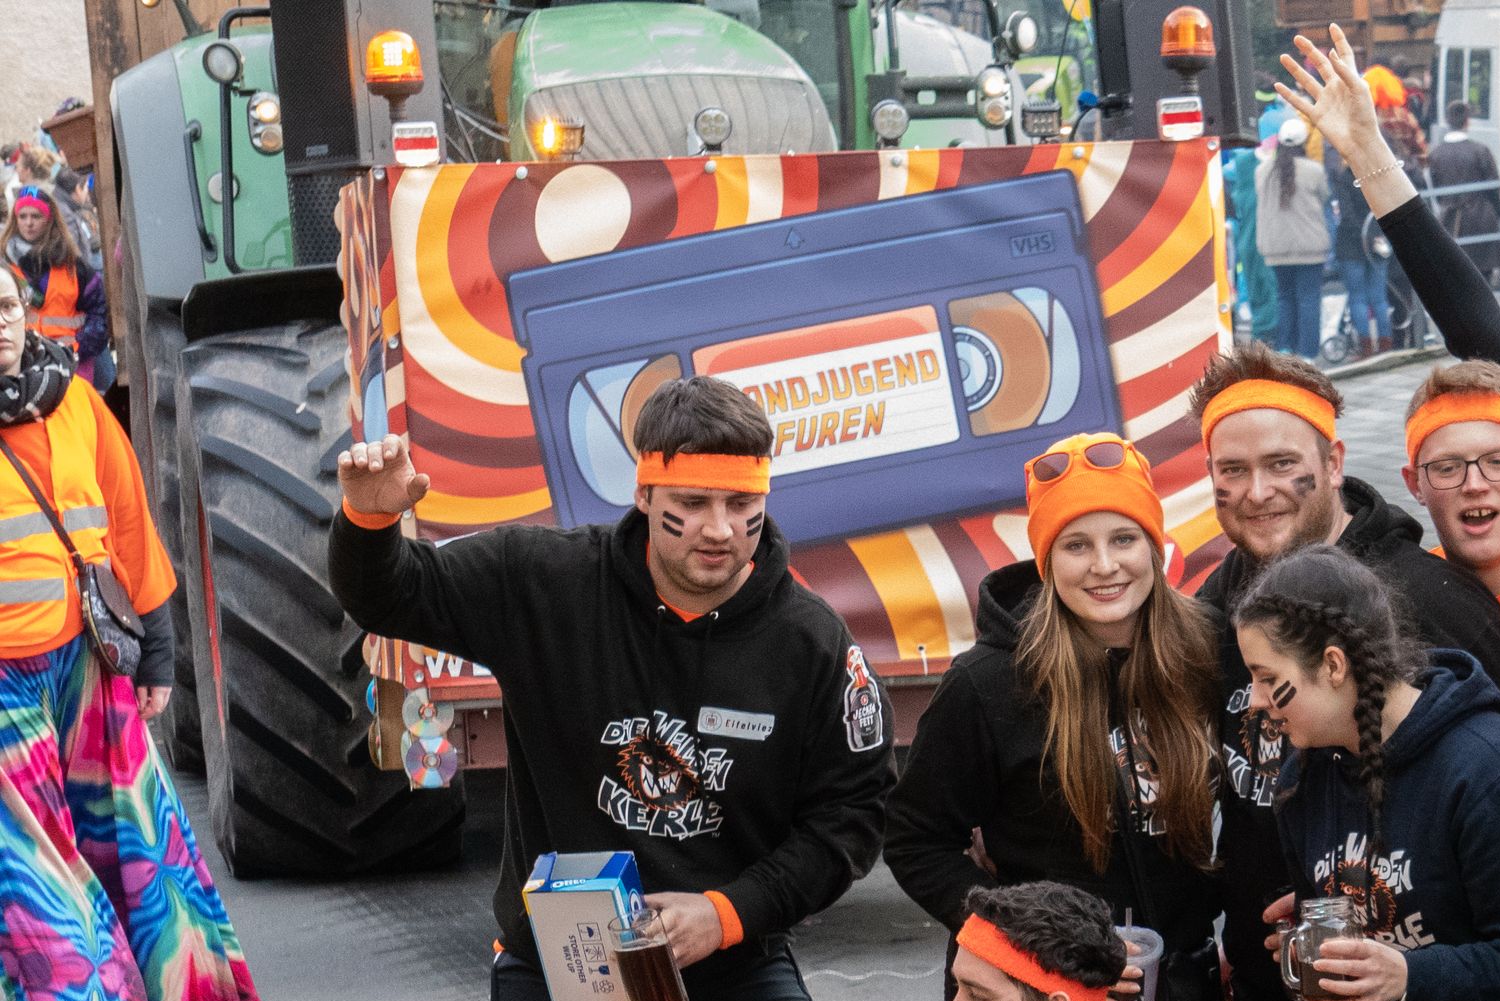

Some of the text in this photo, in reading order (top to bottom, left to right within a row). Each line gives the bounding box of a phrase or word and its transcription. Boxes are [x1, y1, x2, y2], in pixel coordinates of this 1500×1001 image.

[1013, 234, 1051, 254] VHS
[743, 349, 941, 416] ANDJUGEND
[773, 401, 886, 457] FUREN
[598, 775, 724, 841] KERLE
[1345, 832, 1413, 895] WLDEN
[562, 946, 576, 973] WAY UP
[568, 935, 587, 983] STORE OTHER
